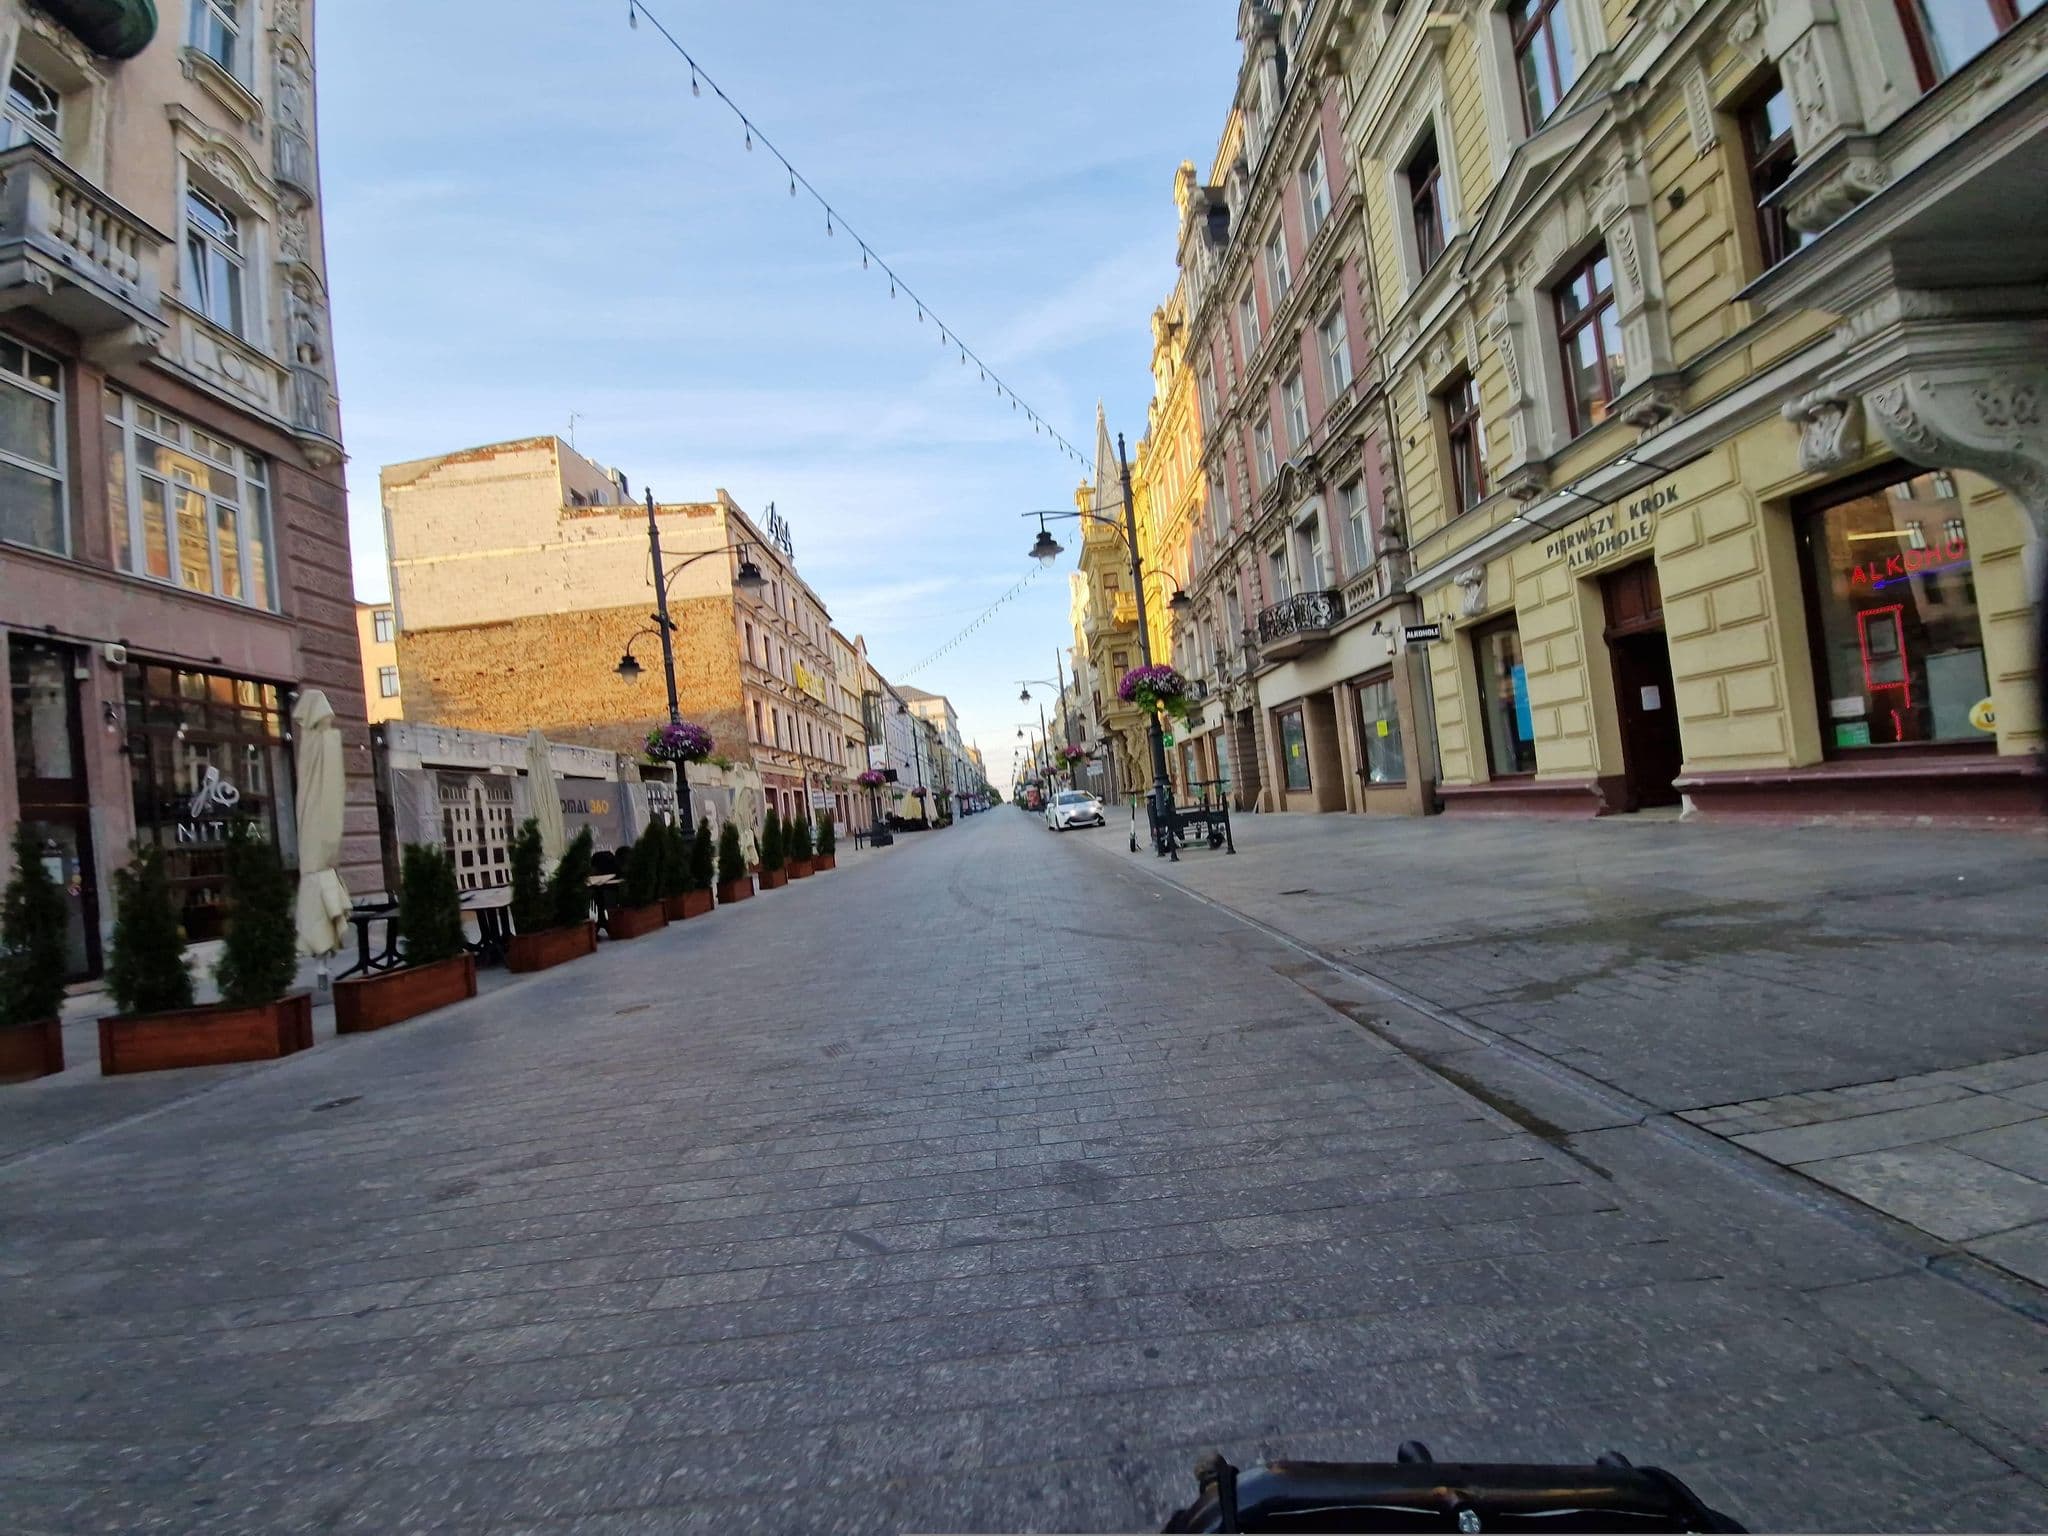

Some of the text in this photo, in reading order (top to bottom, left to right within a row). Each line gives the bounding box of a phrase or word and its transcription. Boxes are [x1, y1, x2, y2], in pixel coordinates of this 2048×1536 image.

[1546, 484, 1678, 559] PIERWSZY KROK
[1567, 520, 1649, 568] ALKOHOLE
[1406, 627, 1439, 639] ALKOHOLE
